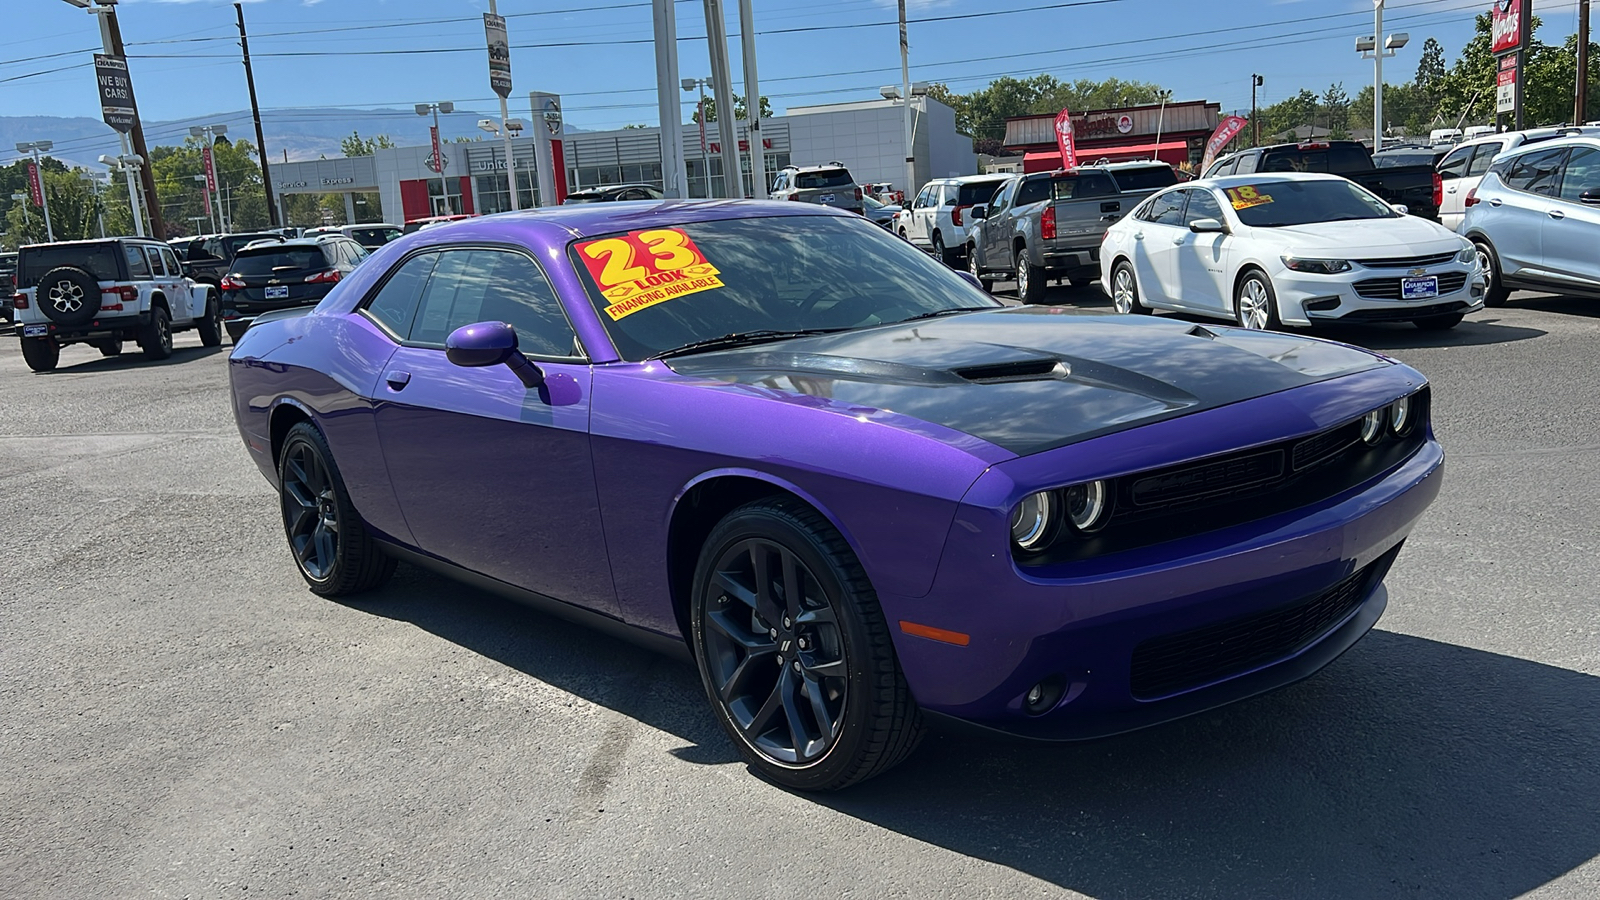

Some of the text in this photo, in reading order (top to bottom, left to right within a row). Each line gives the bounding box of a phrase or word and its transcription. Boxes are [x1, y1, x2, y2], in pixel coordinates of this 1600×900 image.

[1492, 4, 1519, 48] Wendy's
[97, 60, 126, 69] CHAMPION
[98, 75, 128, 88] WE BUY
[104, 88, 128, 99] CARS!
[108, 115, 133, 125] Welcome!
[277, 177, 353, 189] Service Express
[1227, 186, 1257, 203] 18
[584, 229, 701, 286] 23
[634, 269, 690, 291] LOOK
[609, 277, 719, 317] FINANCING AVAILABLE
